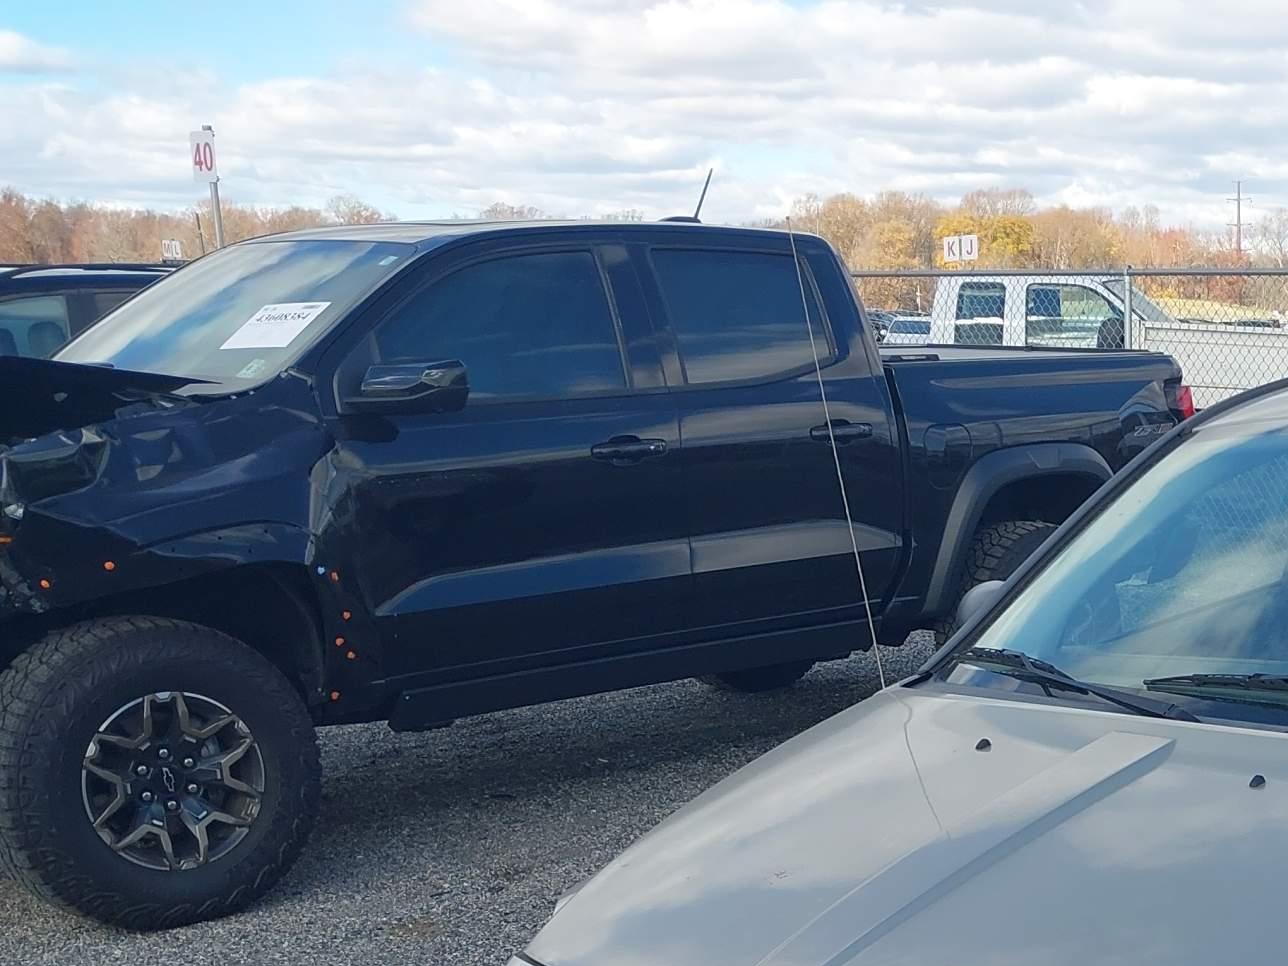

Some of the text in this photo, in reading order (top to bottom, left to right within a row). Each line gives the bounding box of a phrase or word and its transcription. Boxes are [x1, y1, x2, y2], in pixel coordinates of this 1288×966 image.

[194, 142, 213, 172] 40
[947, 240, 956, 257] K
[966, 239, 973, 256] J
